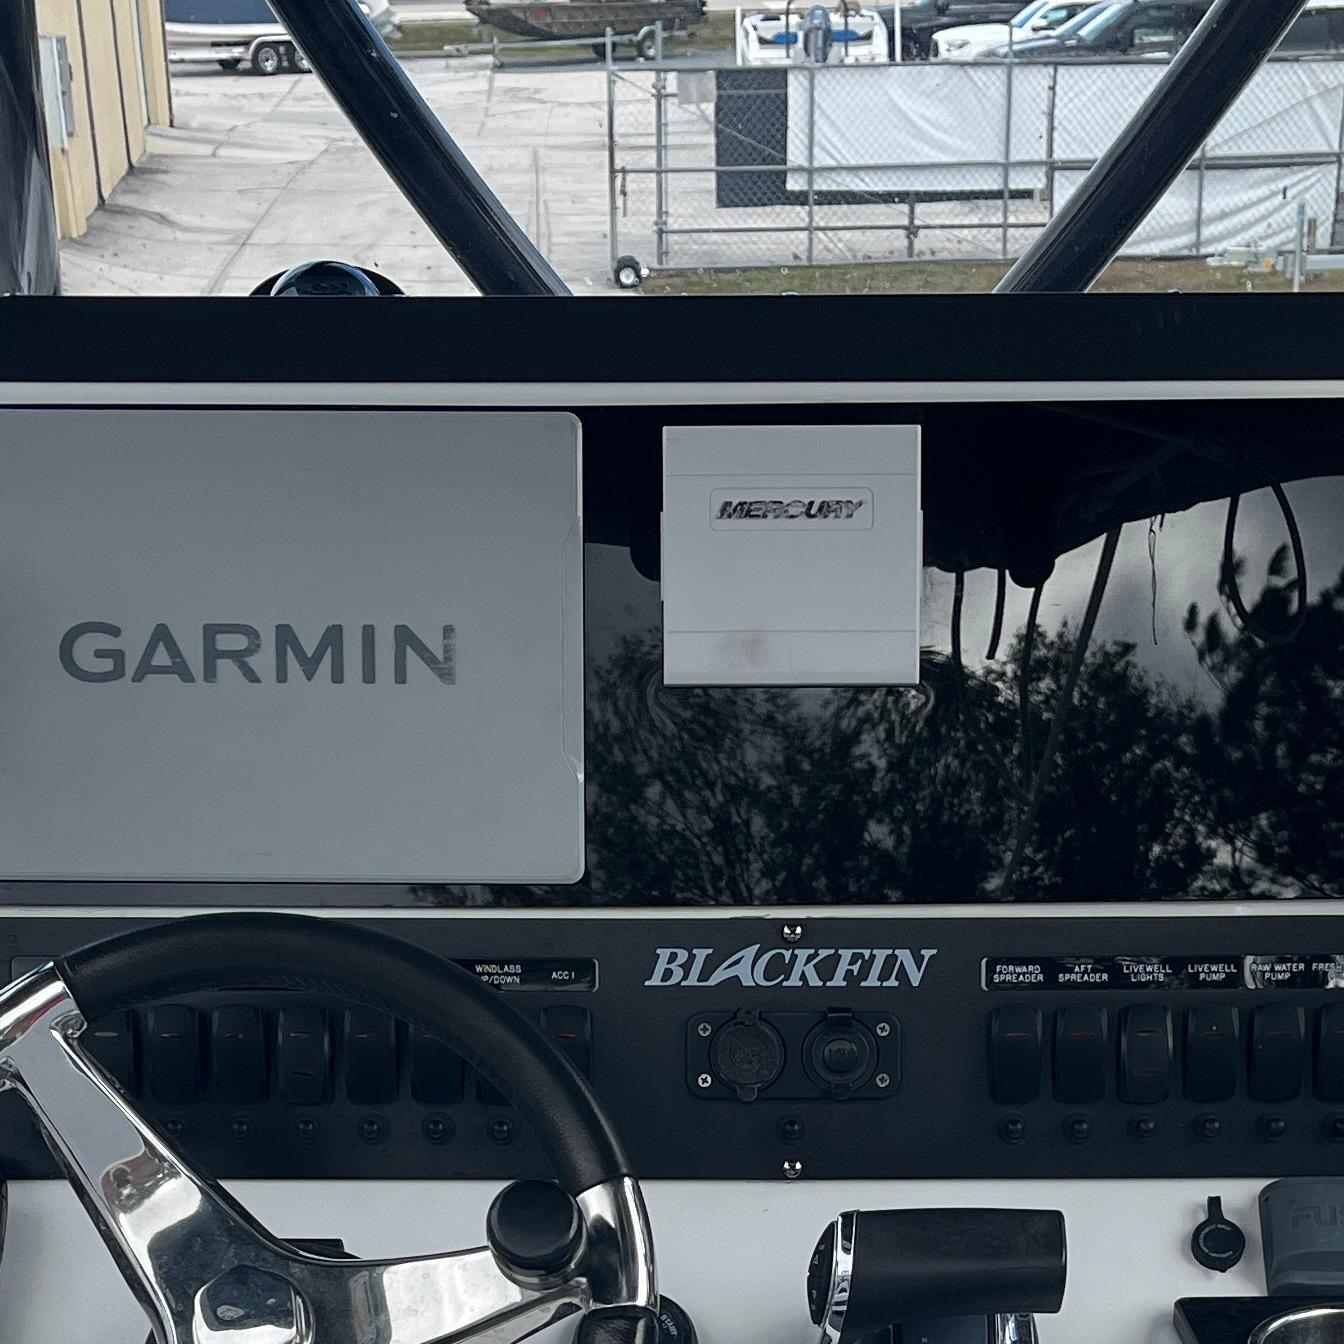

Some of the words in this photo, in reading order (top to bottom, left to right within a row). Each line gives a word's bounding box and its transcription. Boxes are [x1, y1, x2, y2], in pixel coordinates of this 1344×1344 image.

[715, 500, 863, 520] MERCURY
[59, 621, 456, 685] GARMIN
[475, 965, 521, 973] WINDLASS
[644, 944, 937, 987] BLACKFIN
[996, 965, 1041, 973] FORWARD
[1074, 965, 1093, 973] AFT
[1123, 964, 1172, 973] LIVEWELL
[1188, 964, 1237, 973] LIVEWELL
[1251, 963, 1272, 972] RAW
[1273, 963, 1304, 972] WATER
[481, 975, 520, 984] P/DOWN
[551, 971, 569, 979] ACC
[993, 973, 1044, 982] SPREADER
[1058, 973, 1108, 982] SPREADER
[1130, 973, 1164, 982] LIGHTS
[1199, 973, 1225, 981] PUMP
[1264, 972, 1291, 980] PUMP
[660, 1314, 678, 1336] START
